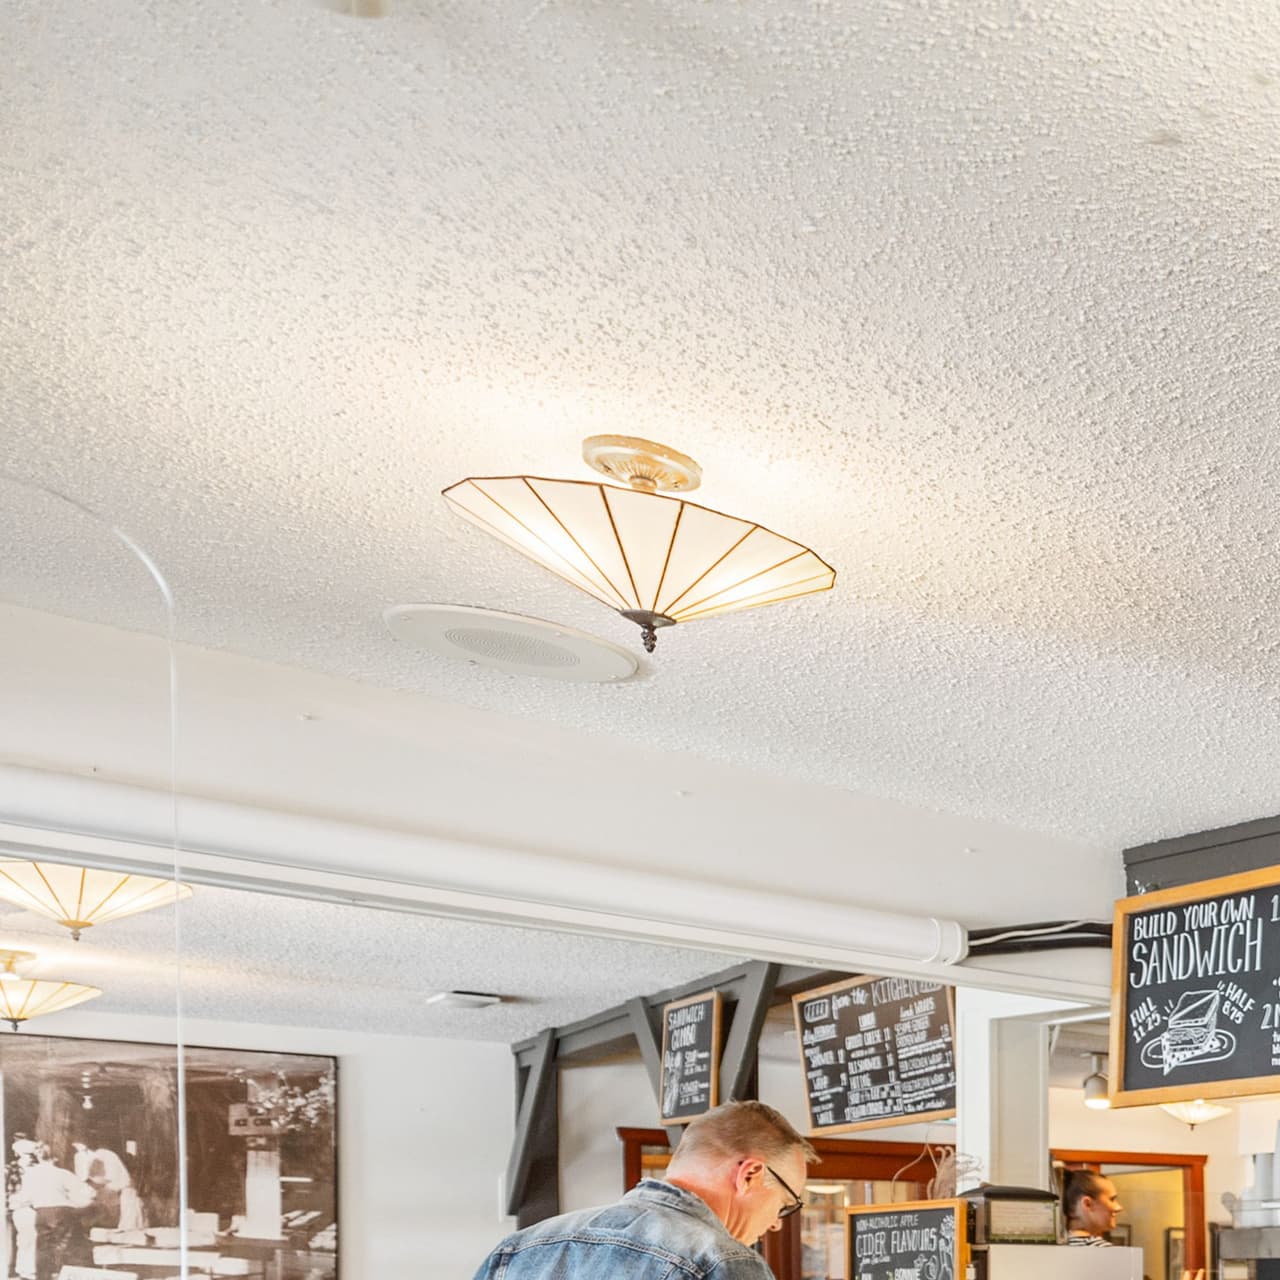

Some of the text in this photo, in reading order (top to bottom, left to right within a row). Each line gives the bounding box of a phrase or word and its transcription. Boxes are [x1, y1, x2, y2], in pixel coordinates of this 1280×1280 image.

[1134, 895, 1255, 941] BUILD YOUR OWN
[1130, 917, 1263, 989] SANDWICH
[1225, 981, 1256, 1012] HALF
[1130, 997, 1157, 1028] FULL
[856, 1228, 937, 1258] CIDER FLAVOURS
